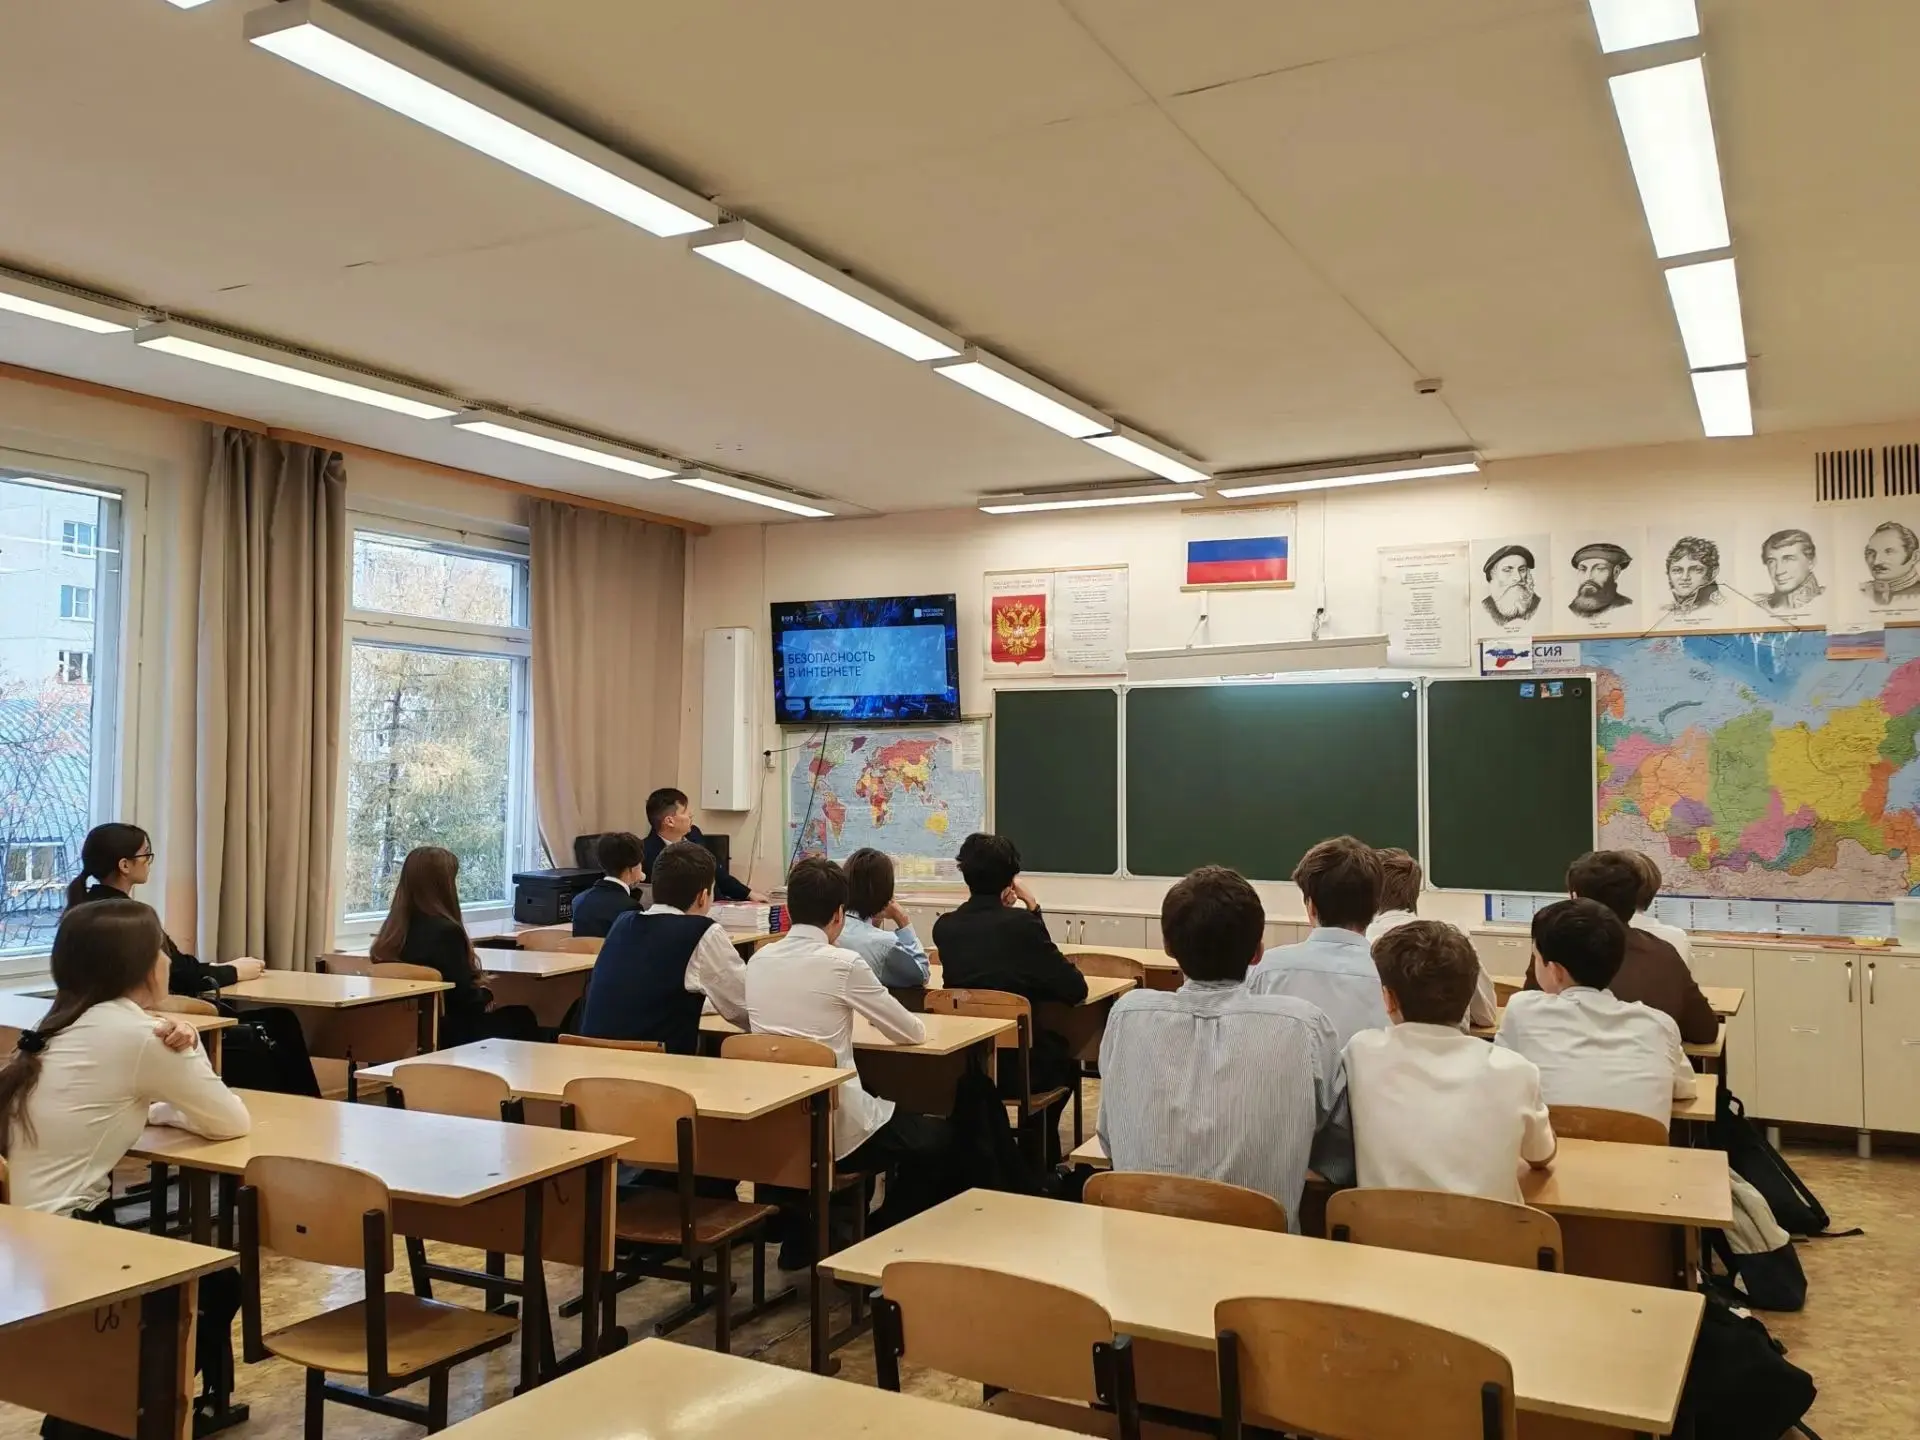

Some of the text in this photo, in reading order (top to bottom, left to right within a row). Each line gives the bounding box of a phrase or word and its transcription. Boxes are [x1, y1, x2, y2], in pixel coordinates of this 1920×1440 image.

[1532, 645, 1562, 657] СИЯ
[787, 651, 876, 664] БЕЗОПАСНОСТЬ
[788, 666, 862, 678] В ИНТЕРНЕТЕ
